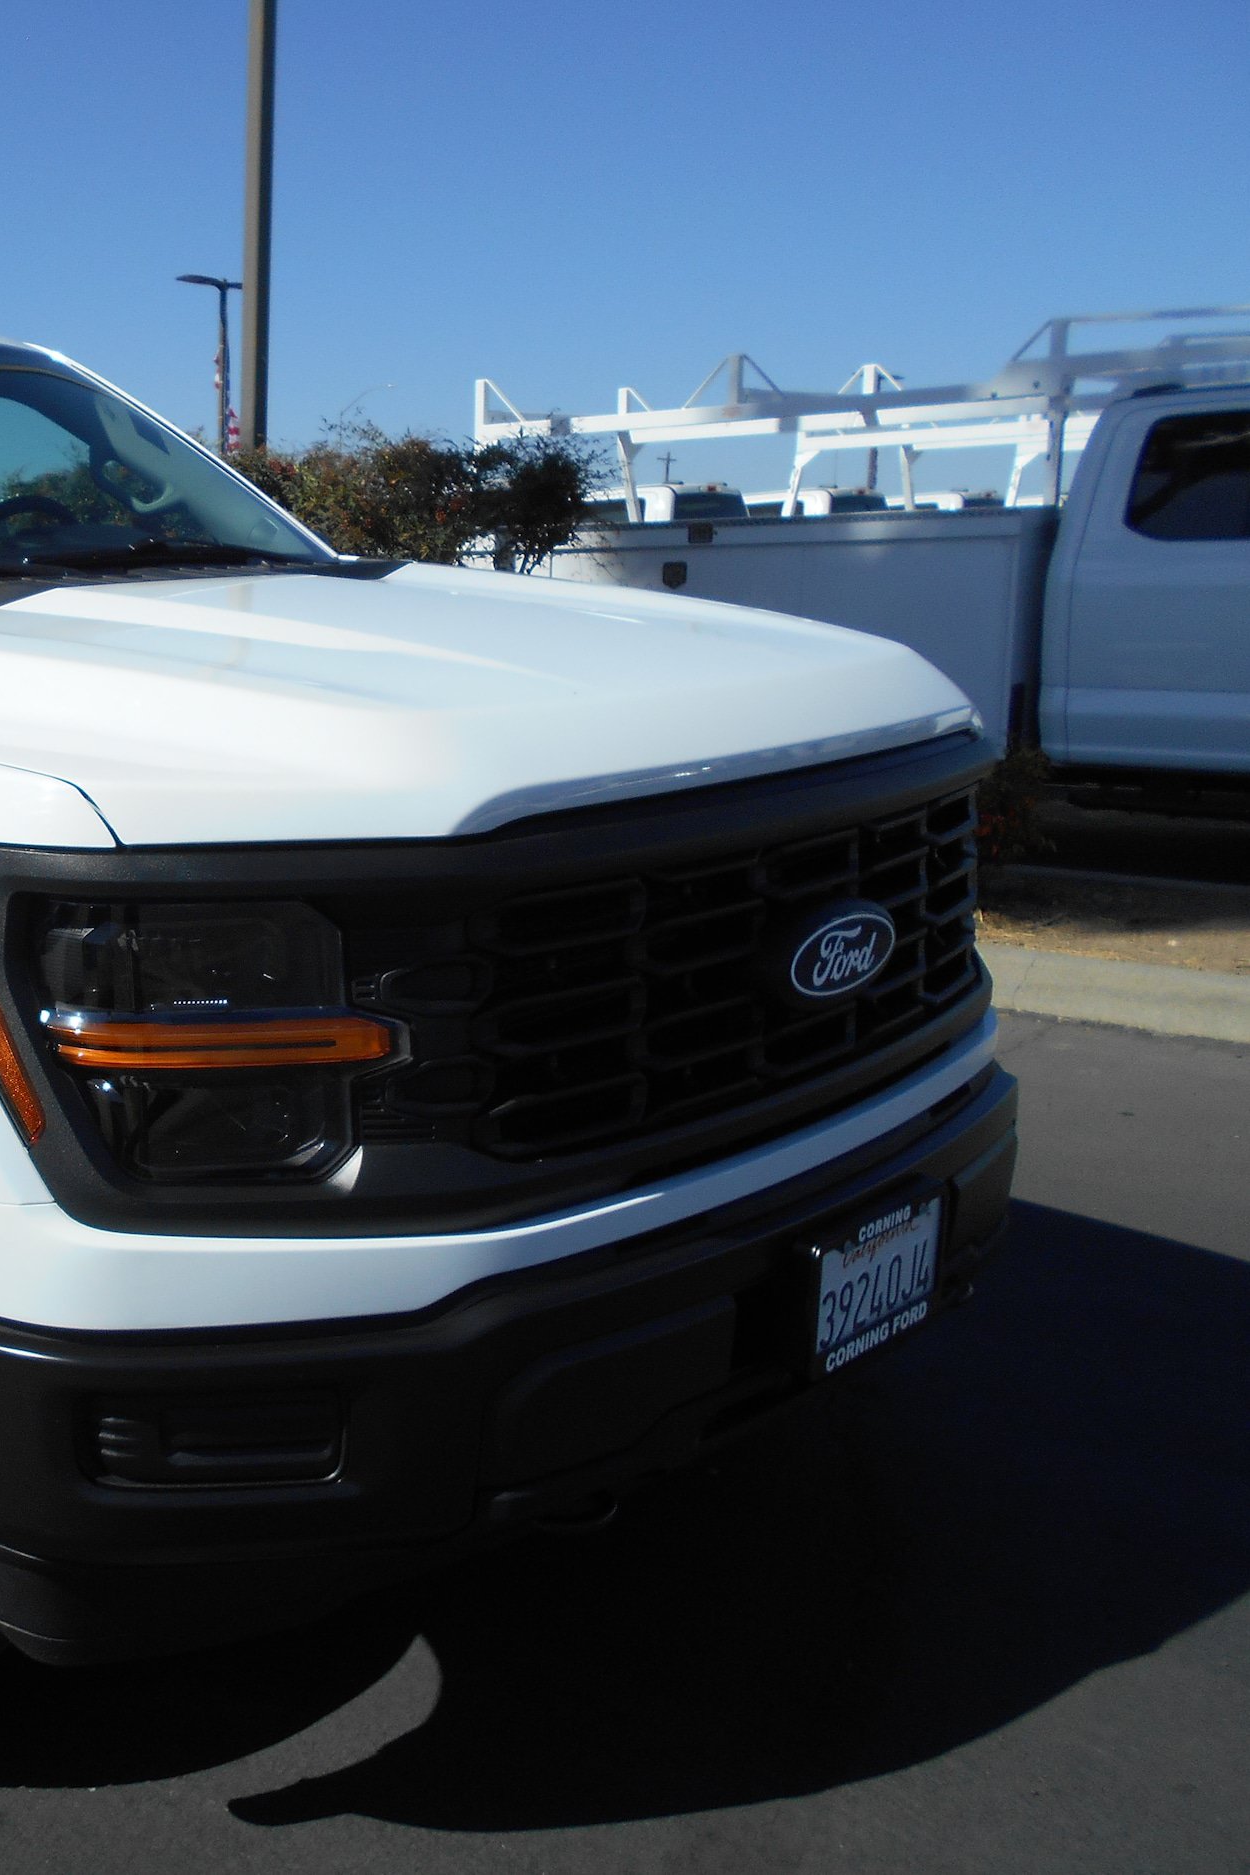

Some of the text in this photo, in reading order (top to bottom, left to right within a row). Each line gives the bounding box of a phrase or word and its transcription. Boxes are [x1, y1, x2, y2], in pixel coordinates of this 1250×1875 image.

[812, 925, 877, 986] Ford
[858, 1205, 912, 1242] CORNING
[819, 1239, 930, 1349] 39240J4
[825, 1301, 928, 1373] CORNING FORD
